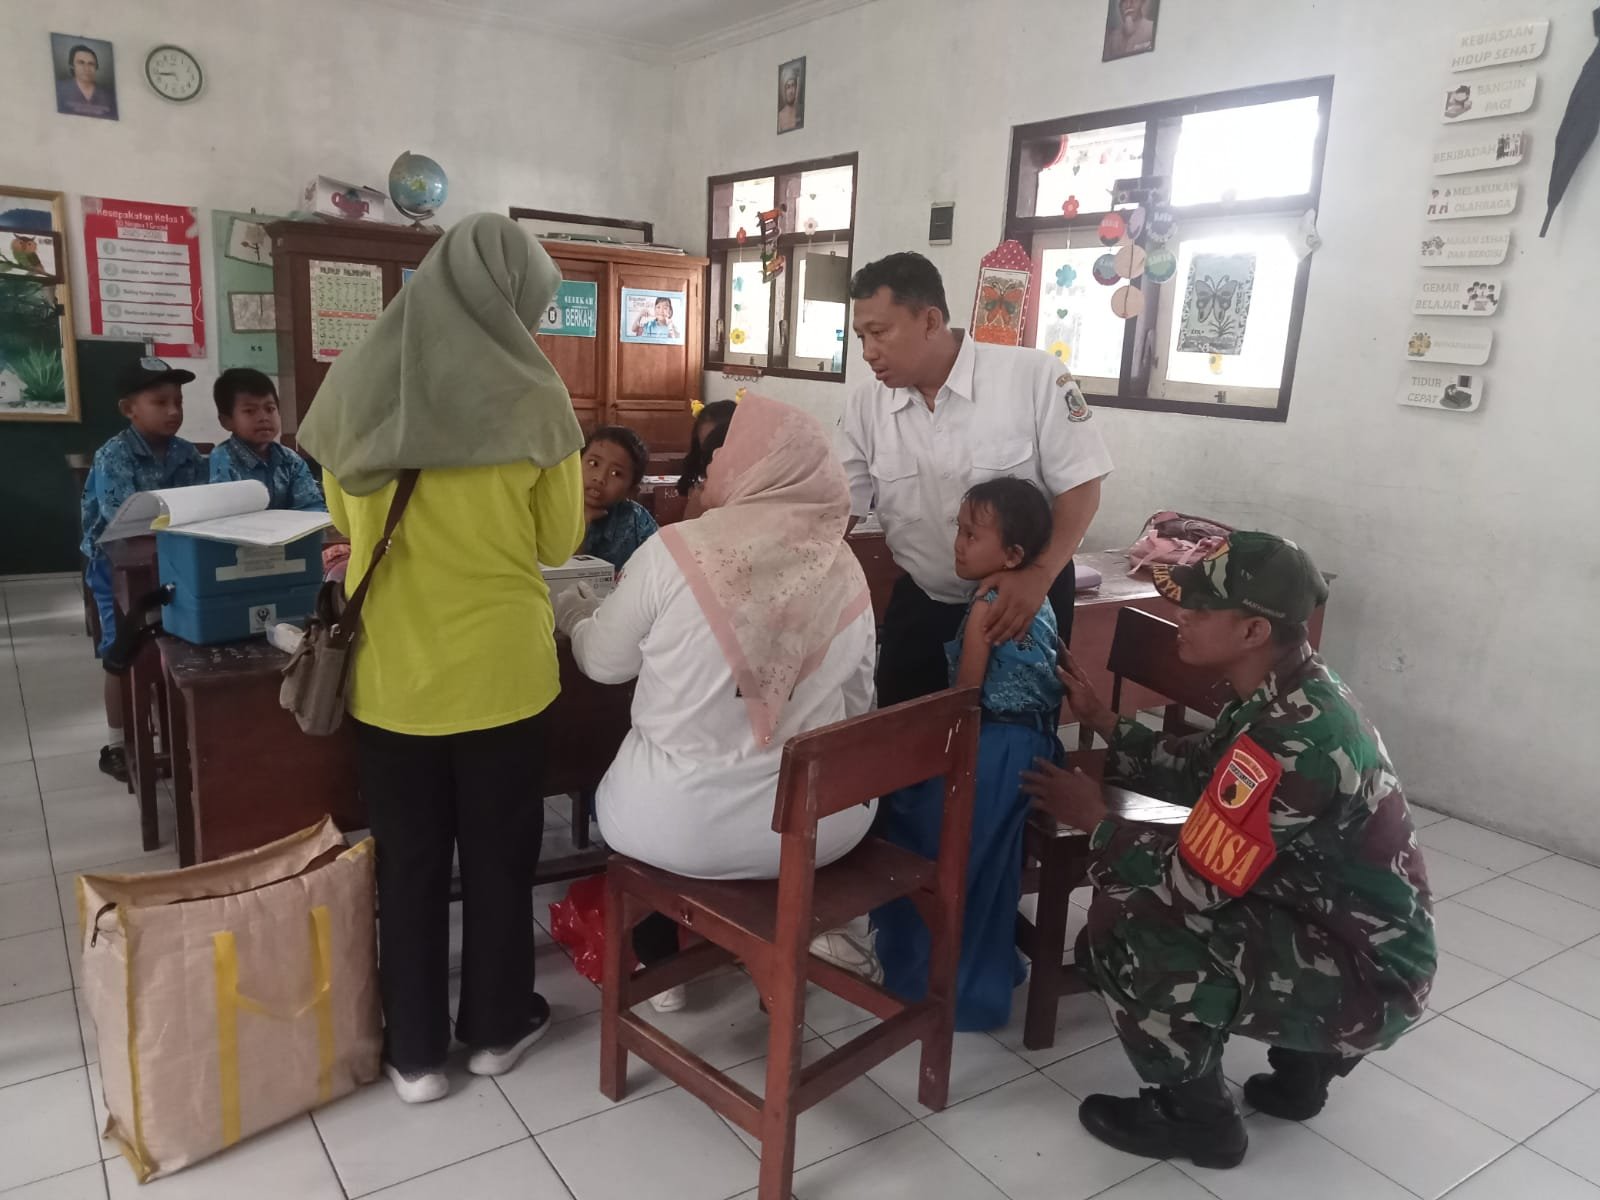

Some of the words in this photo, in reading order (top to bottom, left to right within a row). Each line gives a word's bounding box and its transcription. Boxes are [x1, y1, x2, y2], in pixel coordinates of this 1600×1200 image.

[1460, 25, 1534, 47] KEBIASAAN
[1451, 51, 1492, 67] HIDUP
[1423, 283, 1460, 293] GEMAR
[1415, 299, 1461, 311] BELAJAR
[565, 308, 594, 328] BERKAH
[1411, 376, 1442, 388] TIDUR
